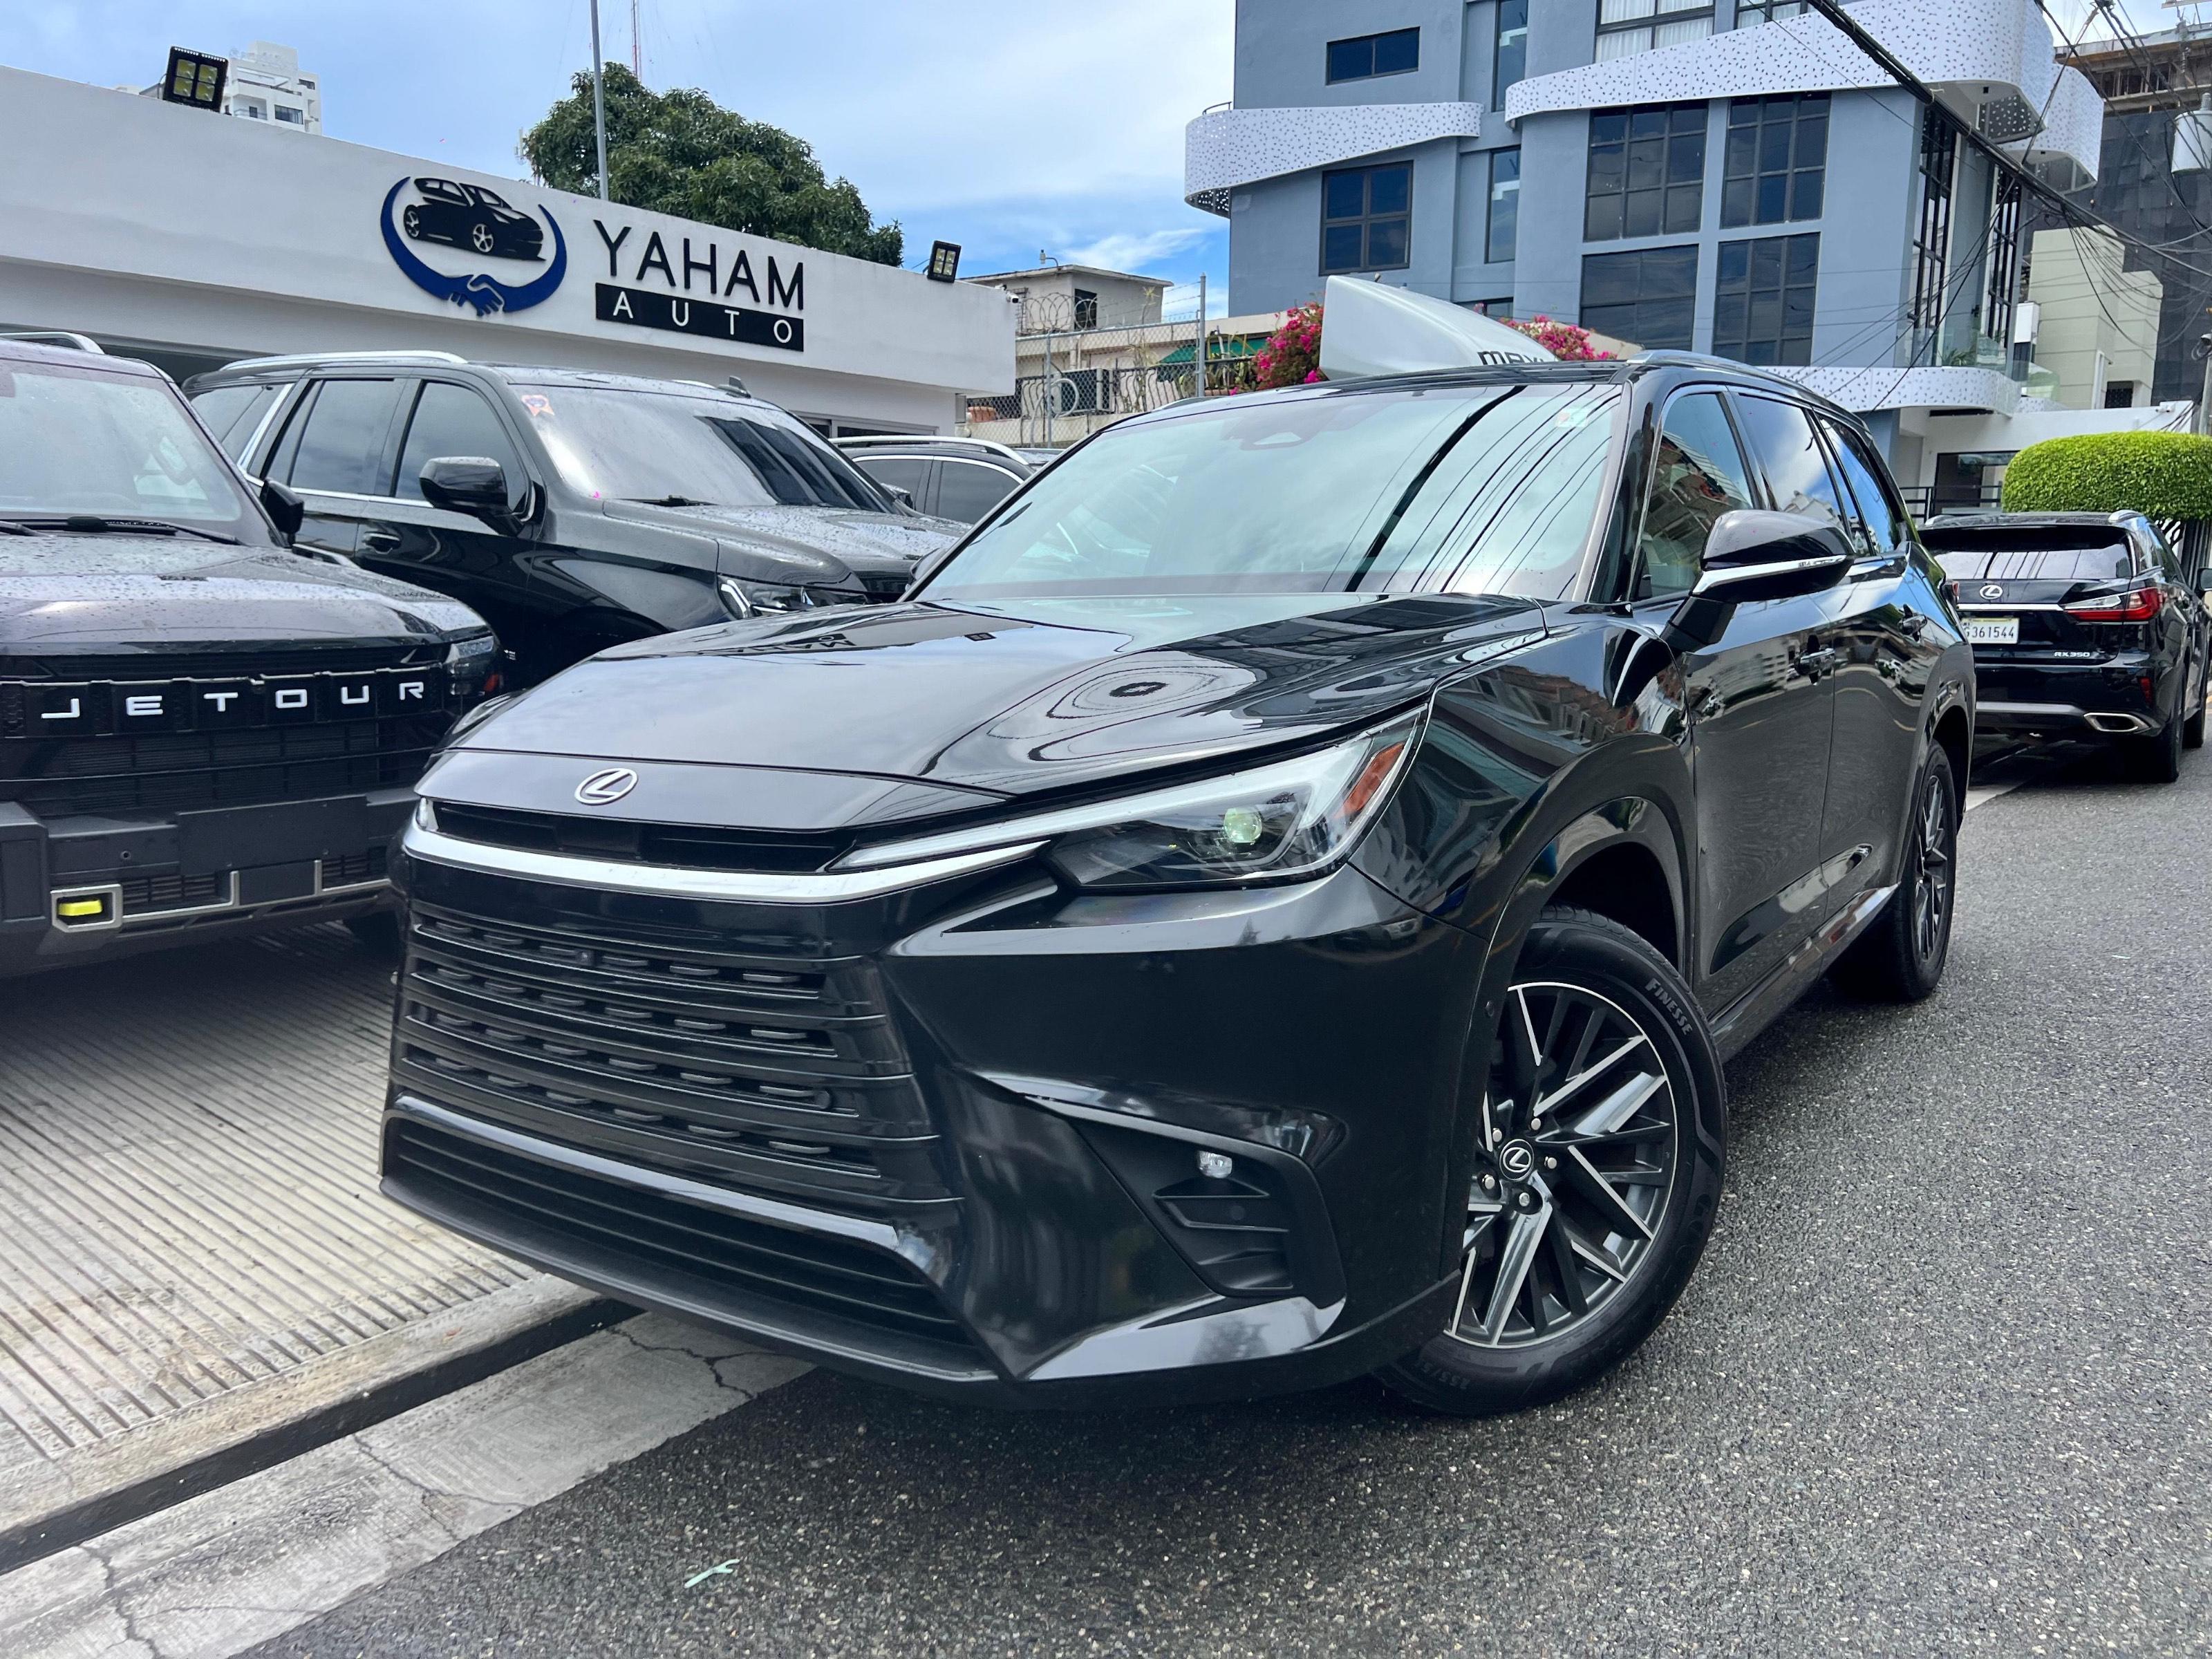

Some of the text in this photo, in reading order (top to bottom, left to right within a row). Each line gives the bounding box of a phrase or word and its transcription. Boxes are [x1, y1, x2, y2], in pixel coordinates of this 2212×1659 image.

[593, 219, 804, 310] YAHAM
[612, 291, 793, 344] AUTO
[41, 681, 424, 719] JETOUR
[1644, 978, 1693, 1035] FINESSE
